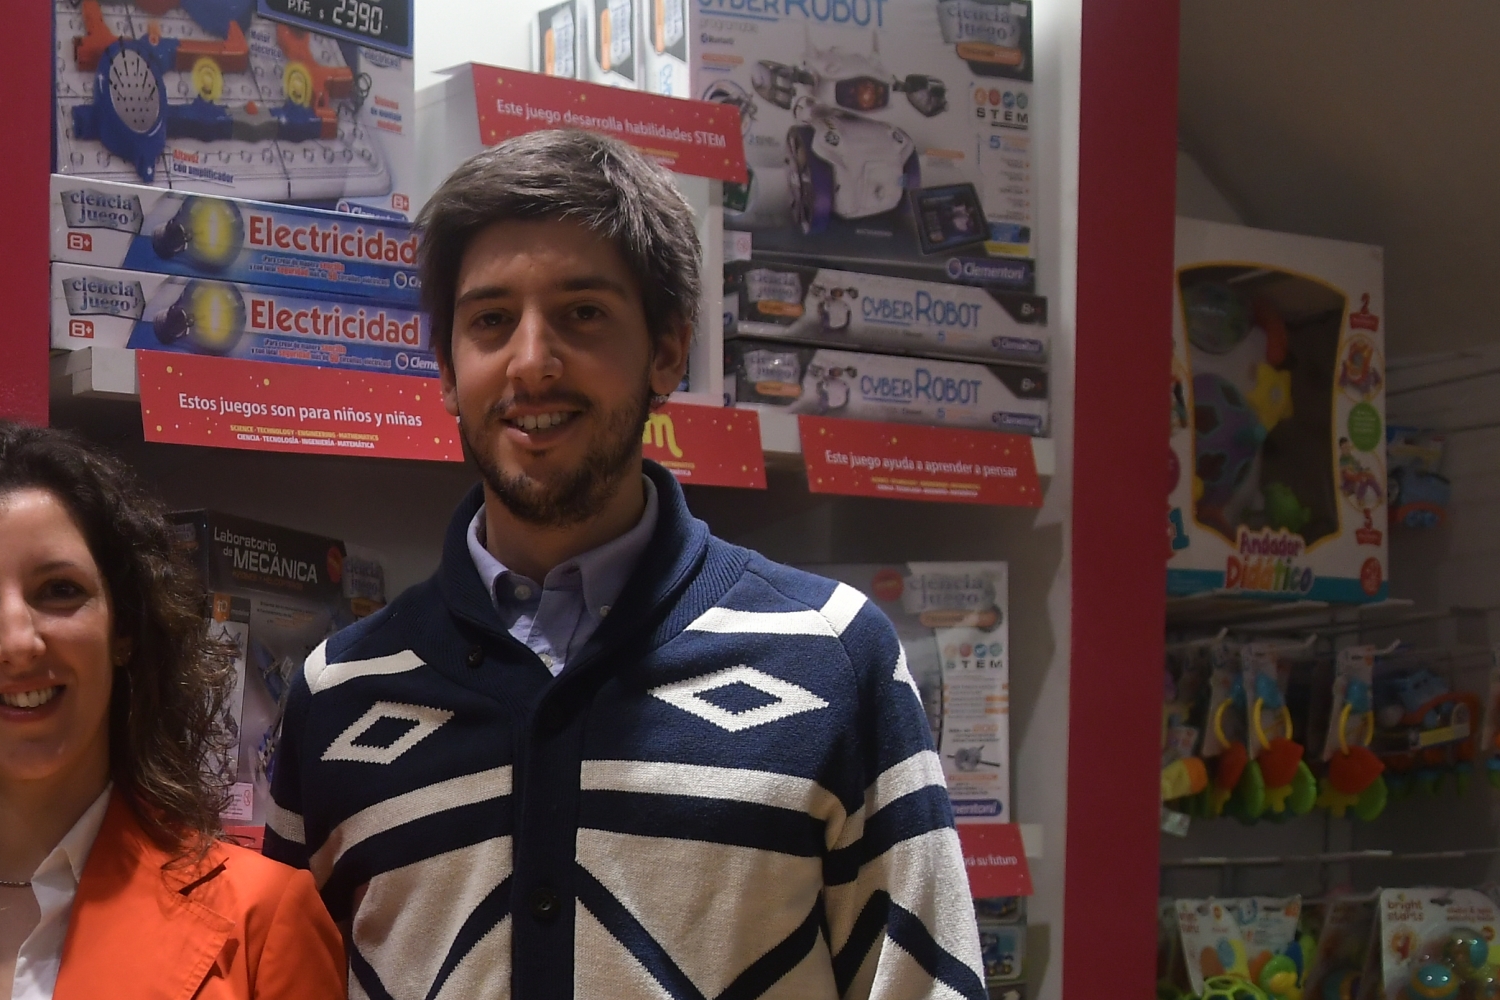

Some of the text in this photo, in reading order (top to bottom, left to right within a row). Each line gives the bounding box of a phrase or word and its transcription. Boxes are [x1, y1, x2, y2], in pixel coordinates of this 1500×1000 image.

[497, 99, 726, 147] Este juego desarrolla habilidades STEM
[250, 217, 417, 264] Electricidad
[251, 300, 419, 346] Electricidad
[179, 394, 216, 411] Estos
[220, 397, 267, 417] juegos
[270, 404, 295, 417] son
[300, 406, 330, 423] para
[334, 405, 371, 423] niños
[386, 410, 422, 426] niñas
[825, 450, 1017, 479] Este juego ayuda a aprender a pensar
[214, 527, 277, 552] Laboratorio
[223, 546, 233, 557] de
[233, 548, 318, 584] MECÁNICA
